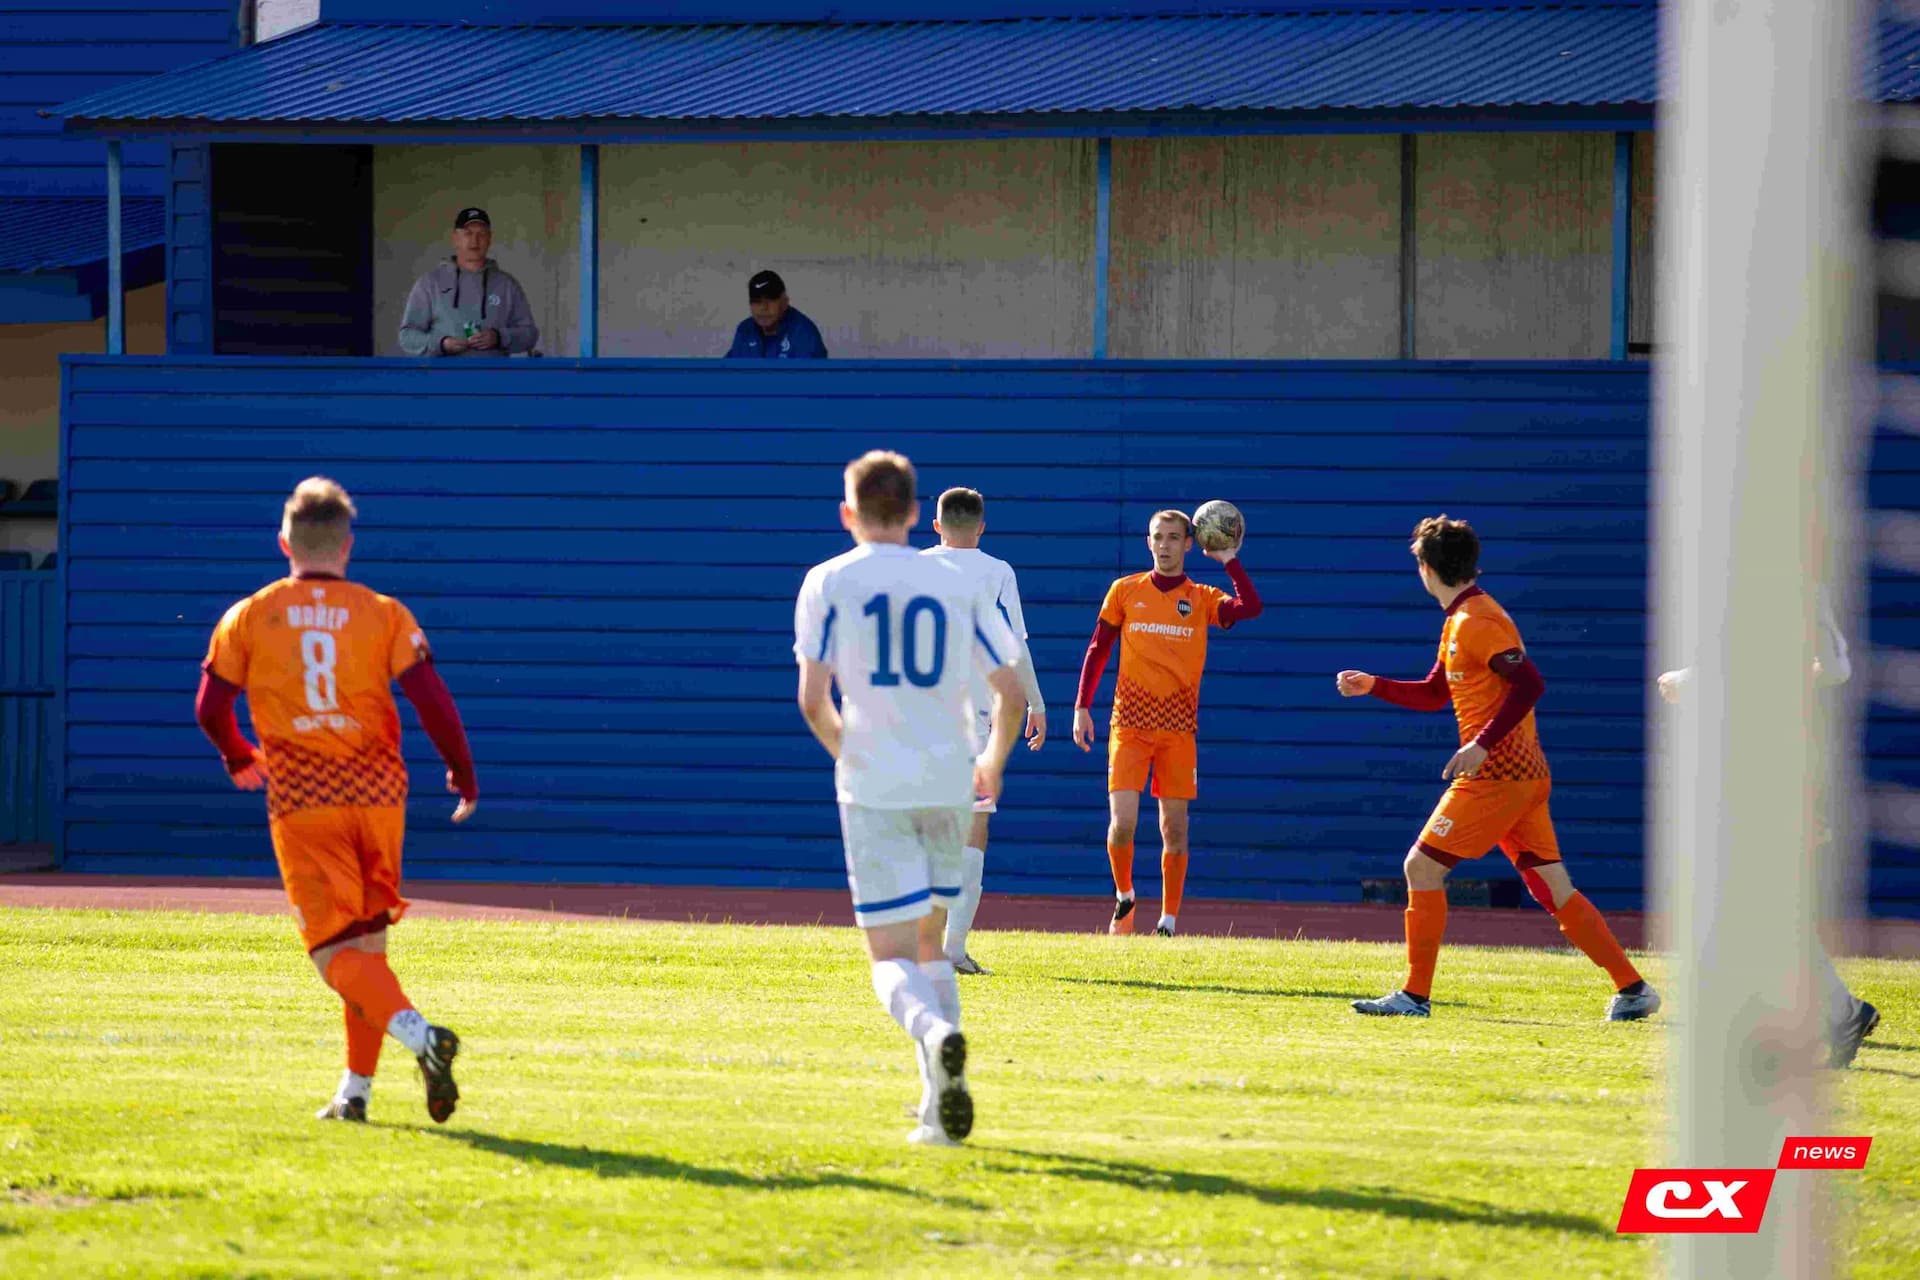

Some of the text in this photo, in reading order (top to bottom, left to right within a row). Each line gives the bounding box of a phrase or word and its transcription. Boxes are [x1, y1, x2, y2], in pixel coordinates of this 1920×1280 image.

[863, 593, 947, 688] 10
[1129, 622, 1194, 637] ПРОДИНВЕСТ
[301, 630, 339, 712] 8
[1431, 815, 1454, 837] 23
